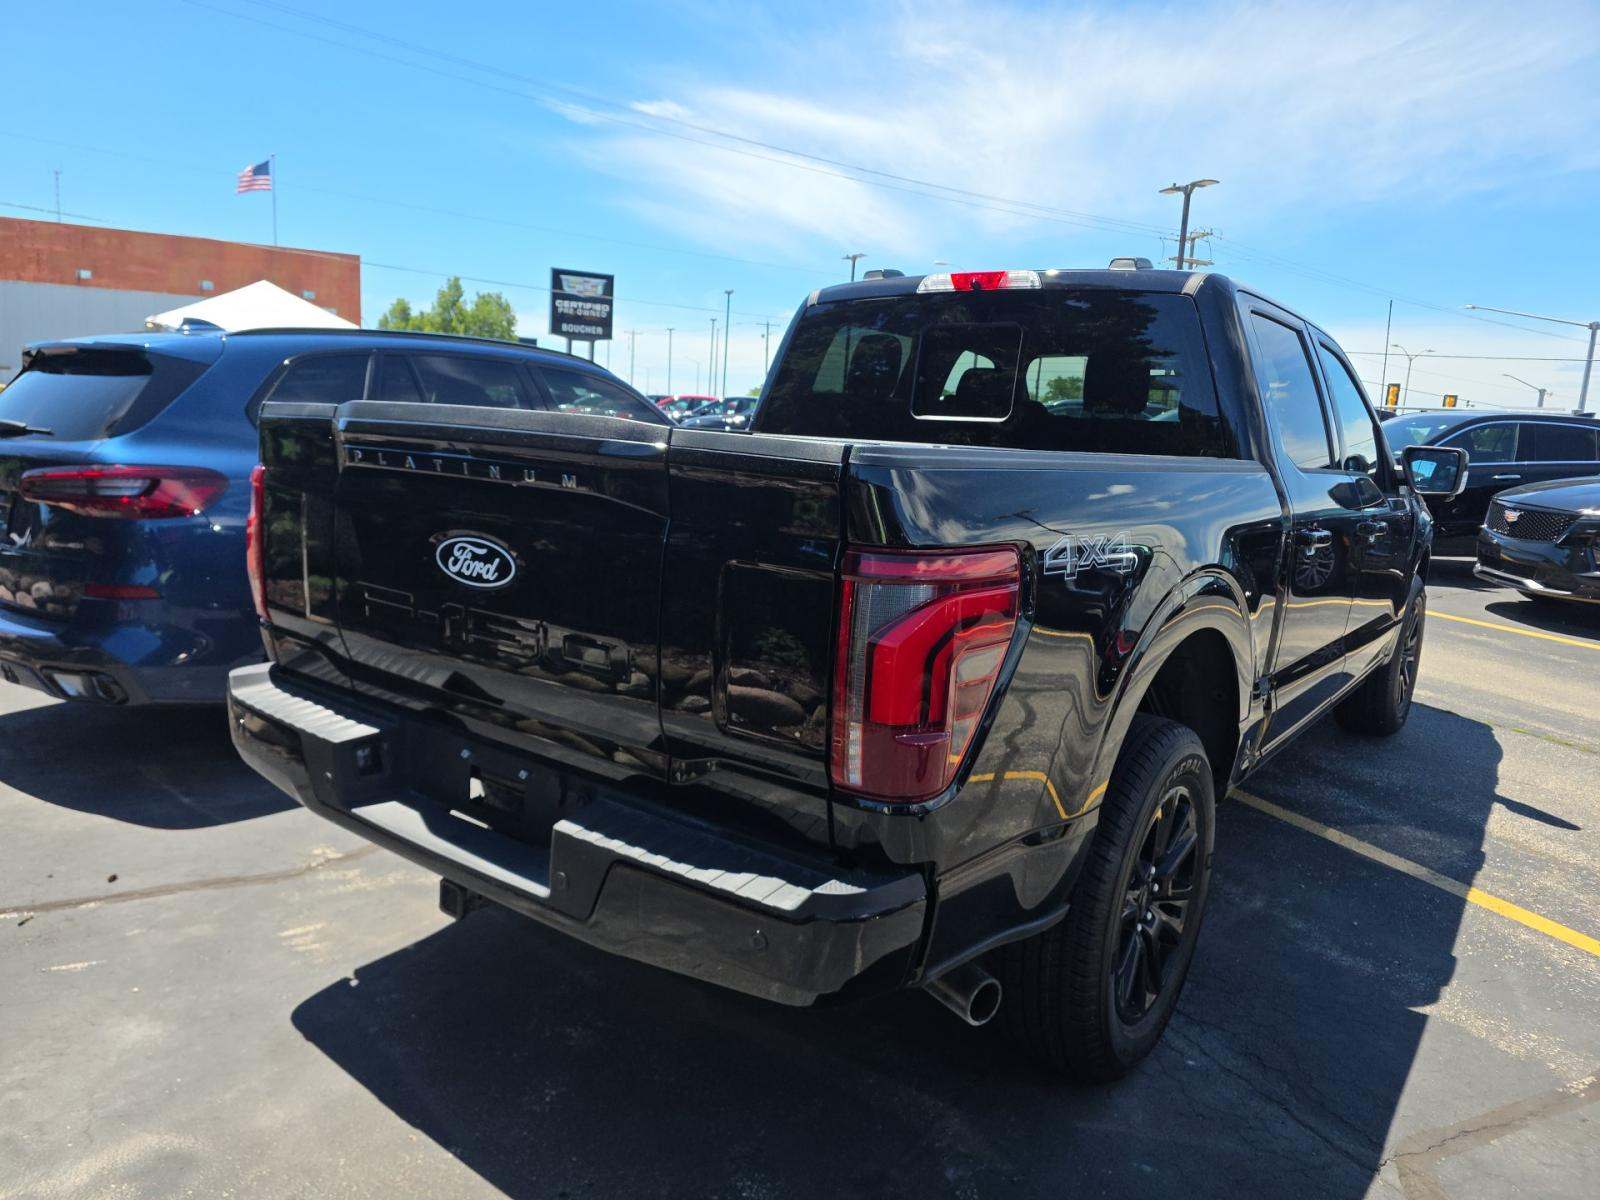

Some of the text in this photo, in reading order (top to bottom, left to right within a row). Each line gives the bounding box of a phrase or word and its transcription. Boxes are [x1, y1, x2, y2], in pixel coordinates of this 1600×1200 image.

[555, 299, 610, 312] CERTIFIED
[561, 322, 604, 335] BOUCHER
[353, 449, 578, 489] PLATINUM
[447, 541, 501, 582] Ford
